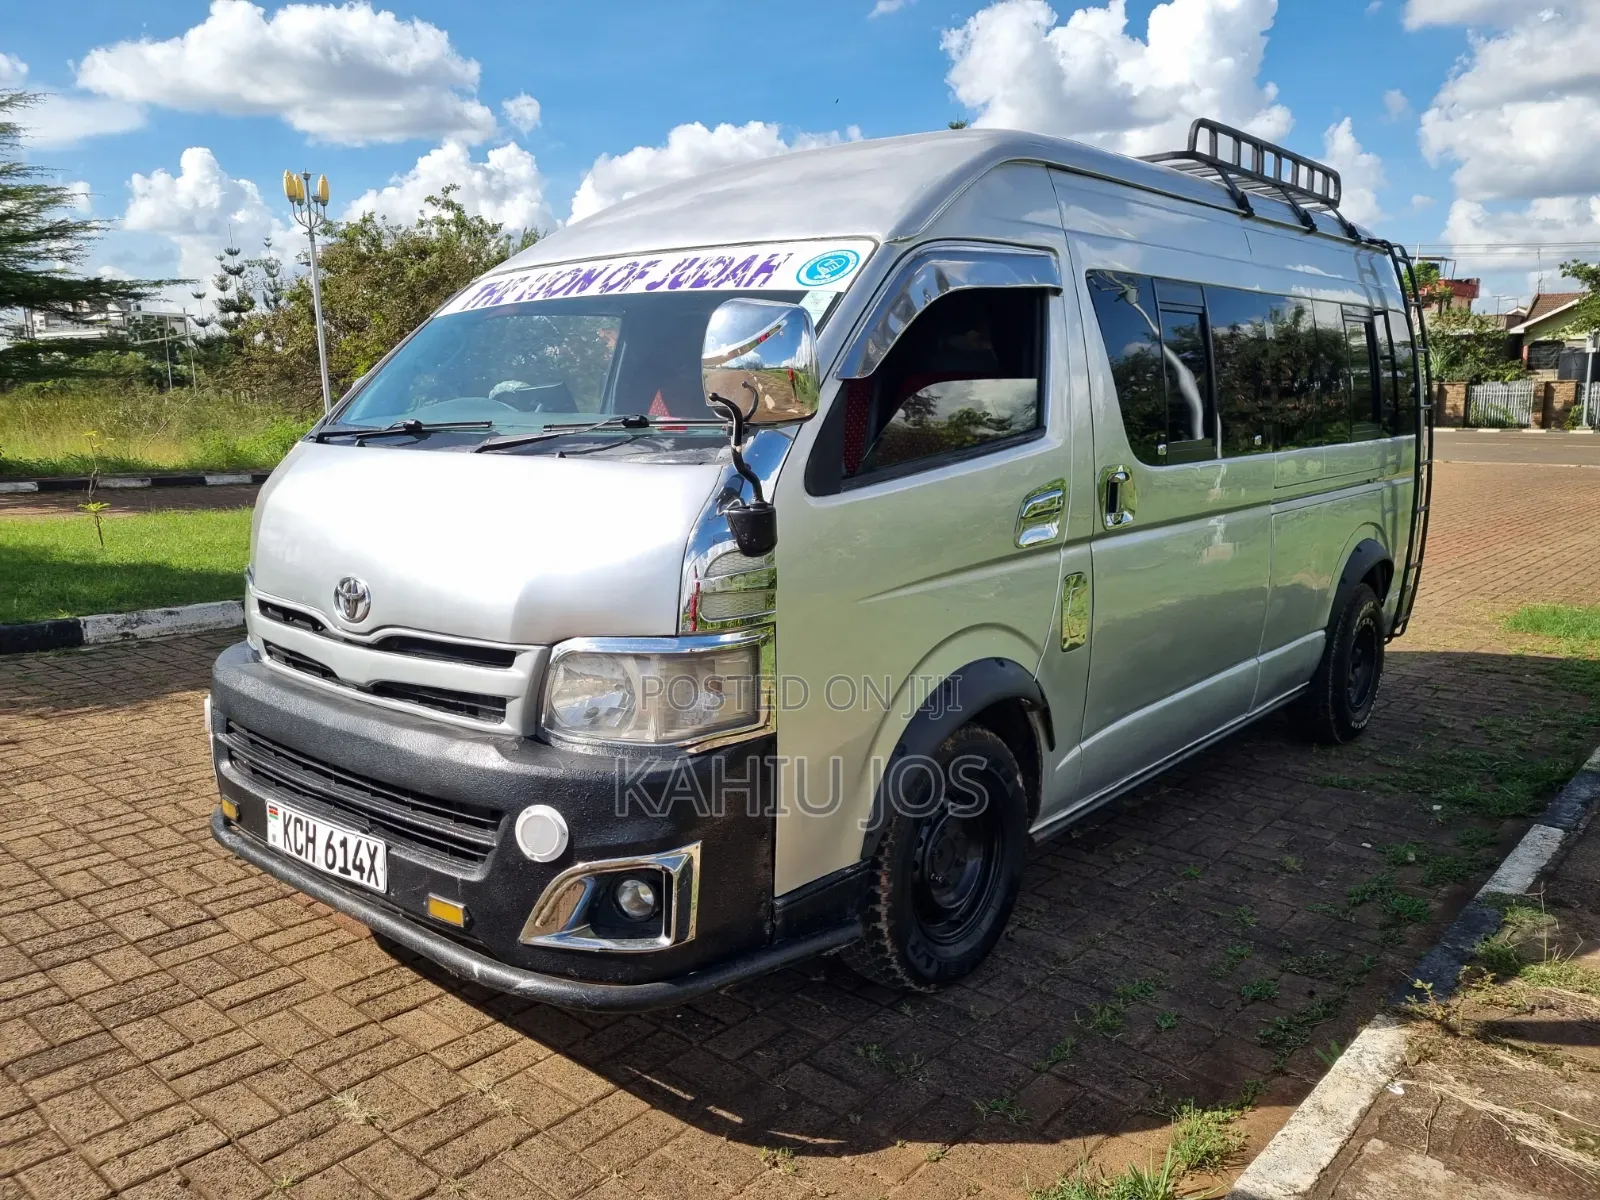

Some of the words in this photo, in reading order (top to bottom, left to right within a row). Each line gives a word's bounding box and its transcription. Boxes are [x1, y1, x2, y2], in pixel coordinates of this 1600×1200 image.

[459, 274, 531, 311] THE
[513, 263, 613, 302] LION
[598, 258, 663, 294] OF
[644, 252, 795, 291] JUDAH
[282, 810, 318, 863] KCH
[324, 830, 380, 888] 614X
